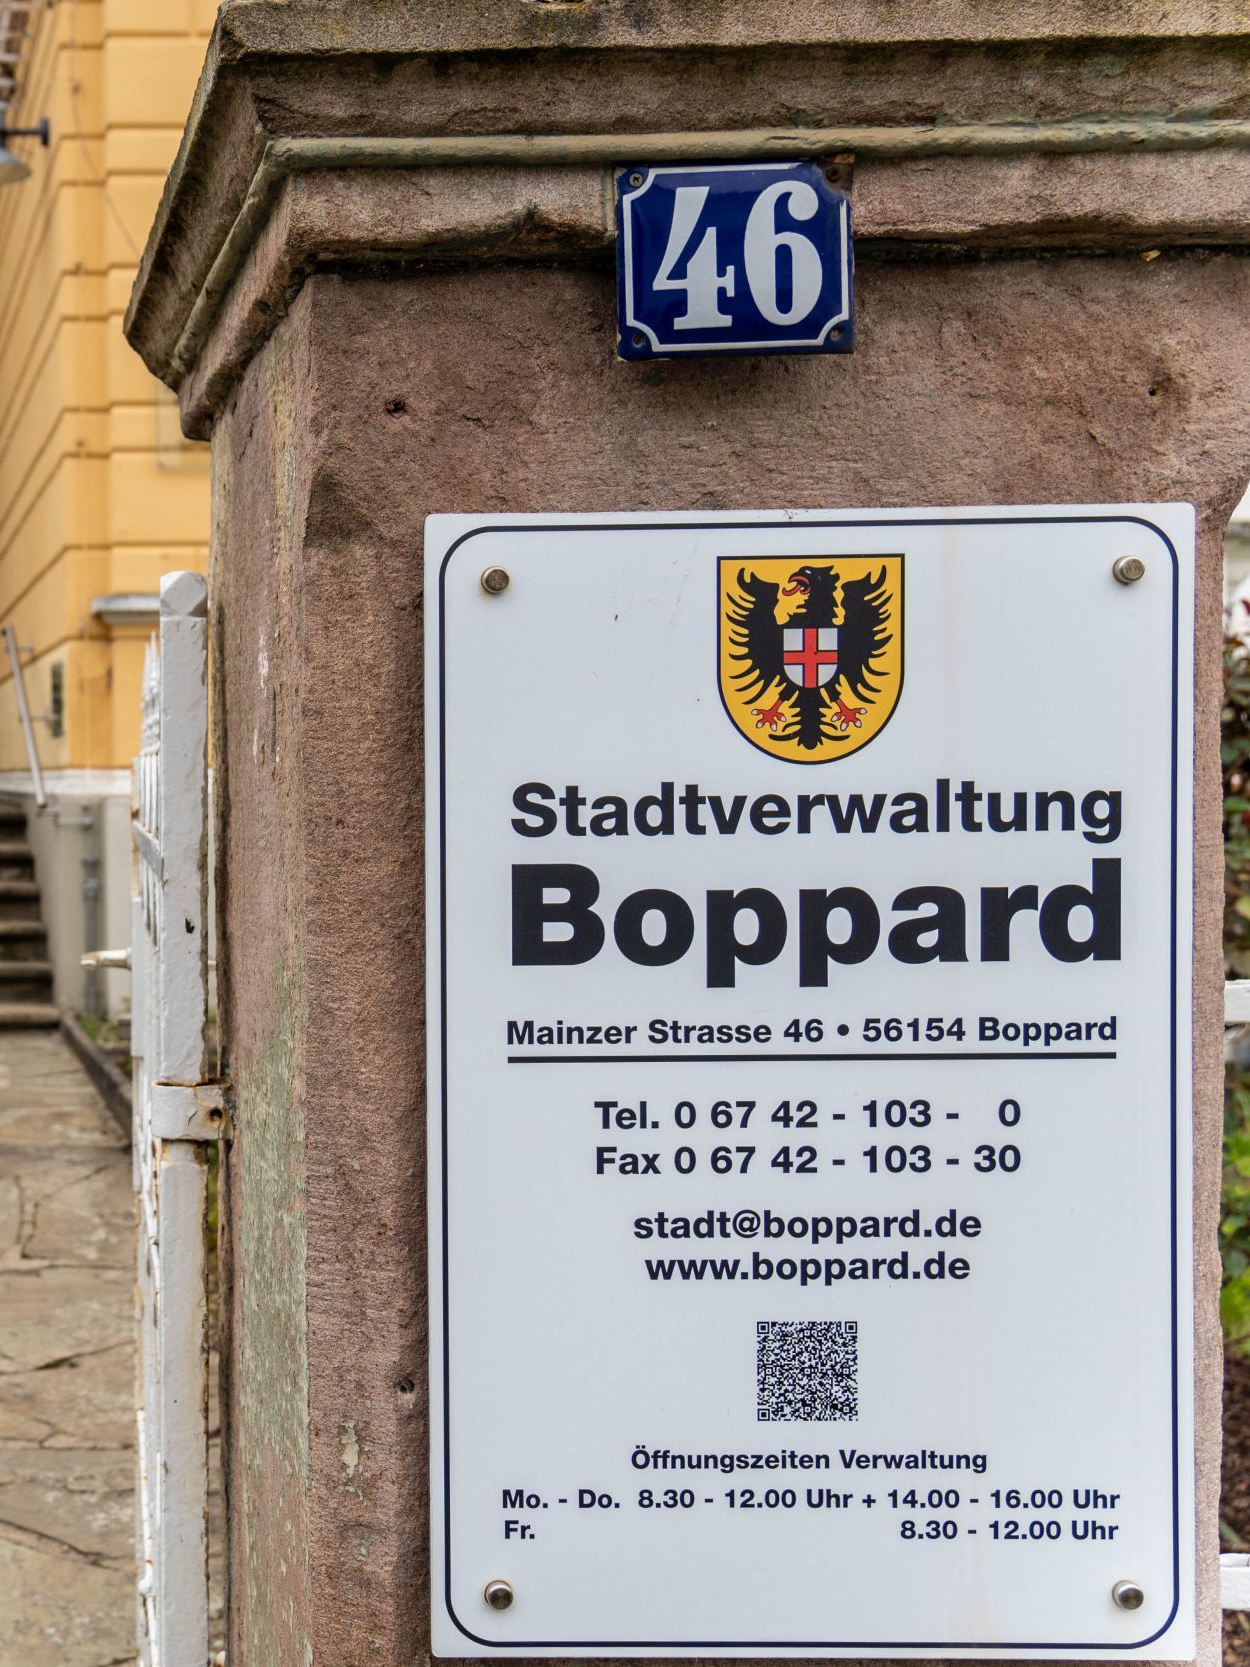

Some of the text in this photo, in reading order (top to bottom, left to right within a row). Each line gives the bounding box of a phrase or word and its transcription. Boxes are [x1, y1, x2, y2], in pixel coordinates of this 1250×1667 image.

[652, 180, 823, 330] 46
[511, 779, 1121, 843] Stadtverwaltung
[512, 858, 1121, 988] Boppard
[507, 1019, 637, 1045] Mainzer
[648, 1019, 771, 1044] Strasse
[784, 1018, 824, 1043] 46
[862, 1017, 965, 1042] 56154
[978, 1016, 1117, 1046] Boppard
[594, 1100, 659, 1129] Tel.
[674, 1101, 697, 1129] 0
[710, 1100, 755, 1128] 67
[770, 1100, 818, 1128] 42
[862, 1100, 932, 1128] 103
[998, 1099, 1021, 1127] 0
[596, 1146, 661, 1175] Fax
[674, 1147, 697, 1175] 0
[710, 1146, 755, 1174] 67
[770, 1146, 818, 1174] 42
[862, 1145, 932, 1174] 103
[973, 1145, 1021, 1173] 30
[633, 1209, 982, 1245] stadt@boppard.de
[645, 1251, 970, 1286] www.boppard.de
[631, 1445, 987, 1474] Öffnungszeiten Verwaltung
[502, 1489, 549, 1509] Mo.
[578, 1489, 620, 1509] Do.
[637, 1489, 695, 1509] 8.30
[724, 1489, 797, 1509] 12.00
[806, 1489, 853, 1509] Uhr
[887, 1489, 960, 1509] 14.00
[990, 1489, 1063, 1509] 16.00
[1073, 1489, 1121, 1509] Uhr
[504, 1520, 535, 1540] Fr.
[900, 1520, 958, 1540] 8.30
[988, 1520, 1062, 1540] 12.00
[1071, 1520, 1119, 1540] Uhr
